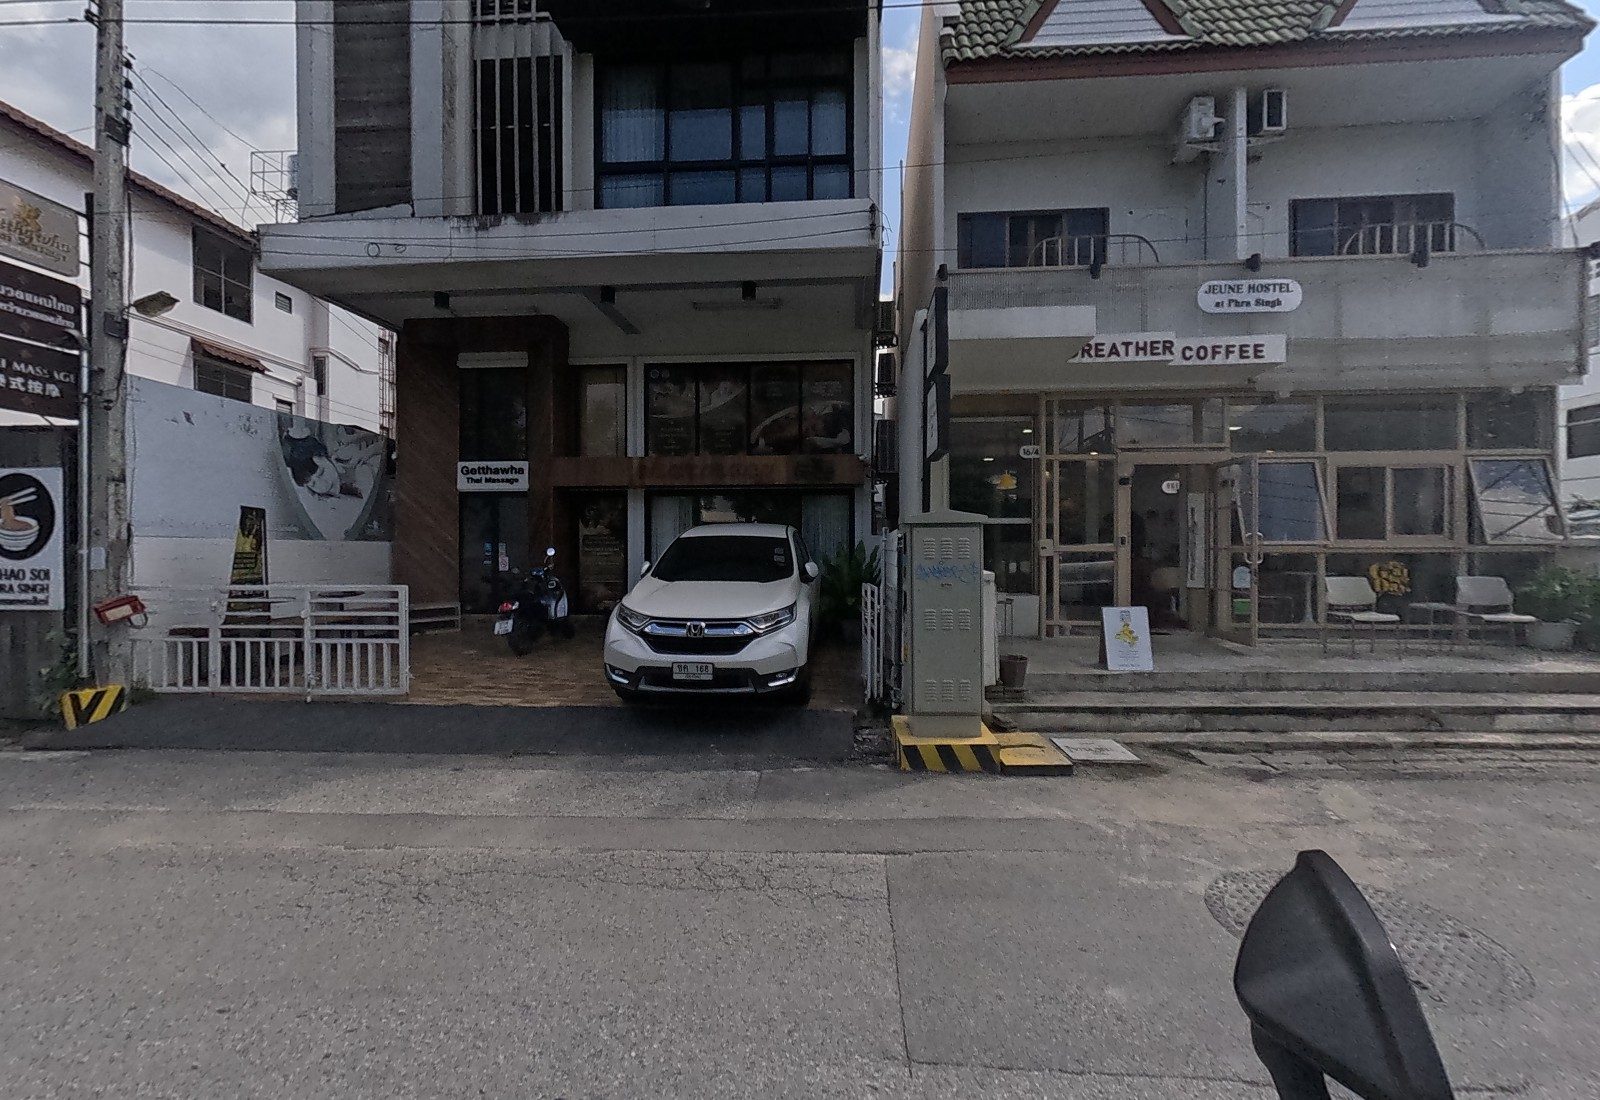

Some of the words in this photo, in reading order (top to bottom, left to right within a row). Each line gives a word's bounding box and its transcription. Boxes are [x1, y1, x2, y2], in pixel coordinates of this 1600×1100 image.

[1204, 284, 1244, 295] JEUNE
[1247, 283, 1294, 294] HOSTEL
[1228, 299, 1252, 308] Phra
[1254, 298, 1282, 308] Singh
[1071, 340, 1175, 358] REATHER
[1181, 344, 1266, 361] COFFEE
[460, 464, 525, 476] Getthawha
[485, 477, 519, 485] Massage
